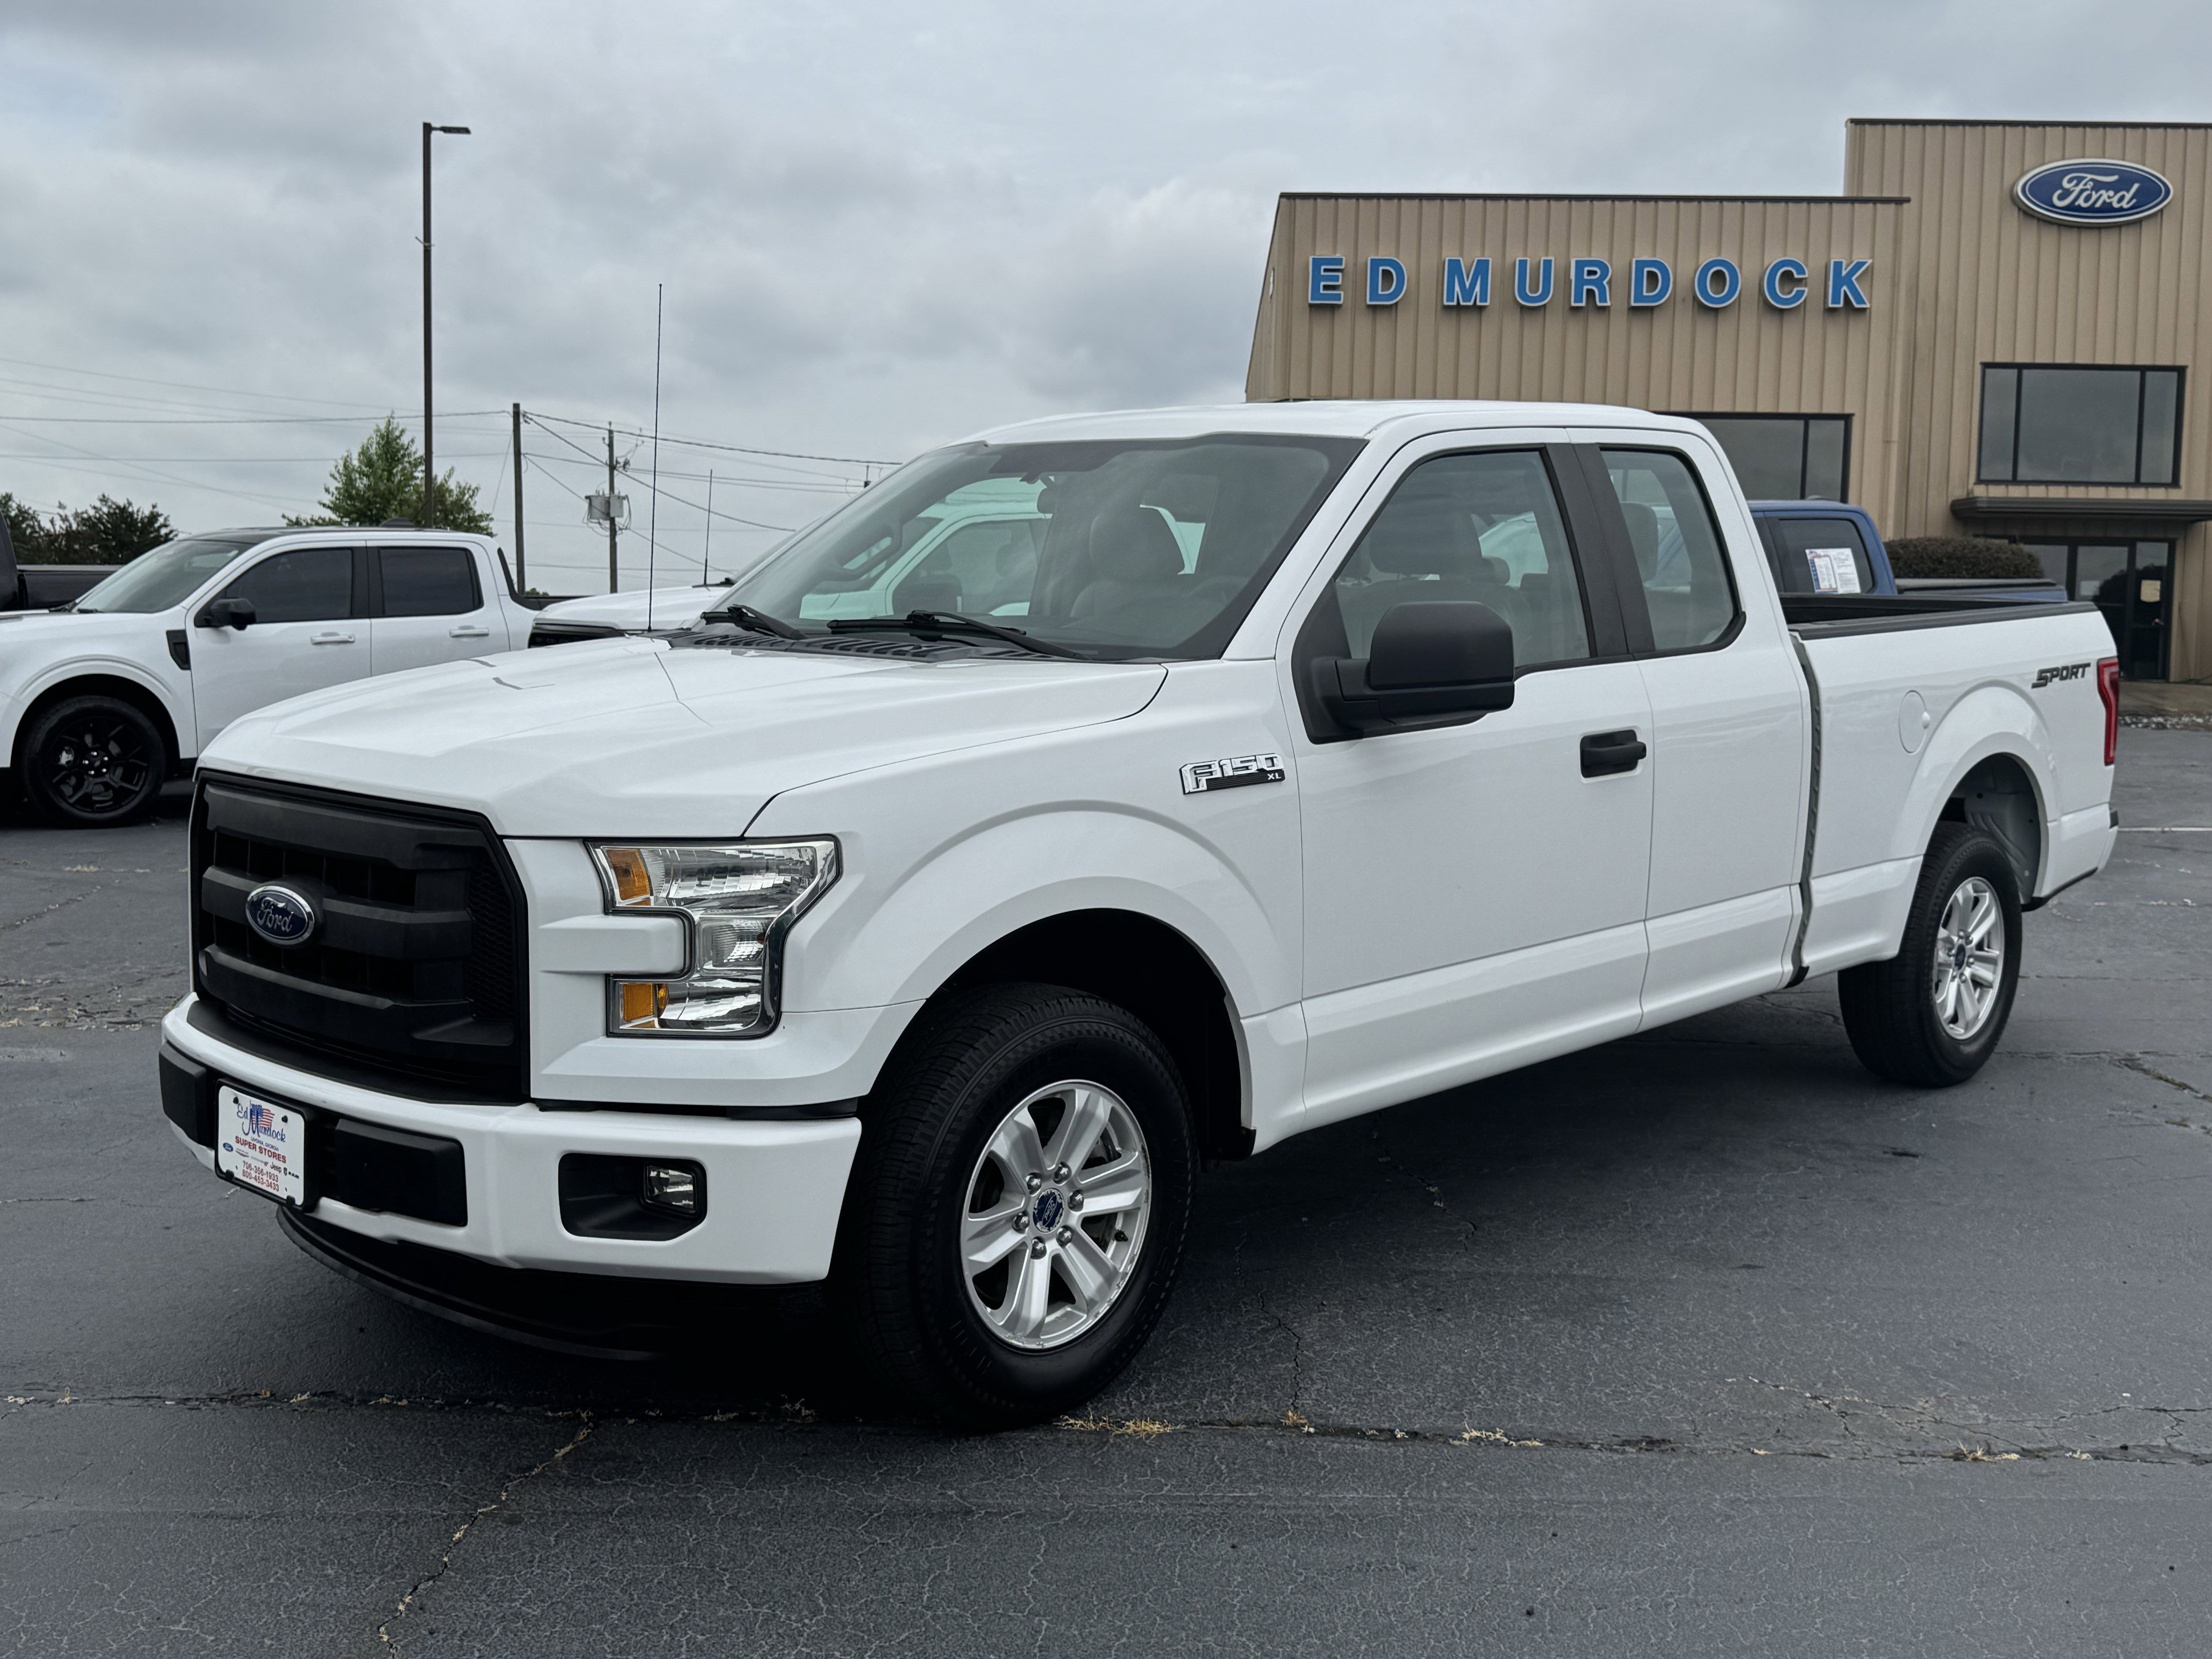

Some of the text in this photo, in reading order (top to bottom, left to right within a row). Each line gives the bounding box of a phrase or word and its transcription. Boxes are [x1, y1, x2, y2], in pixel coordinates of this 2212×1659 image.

[2052, 173, 2140, 208] Ford
[1309, 256, 1872, 309] ED MURDOCK
[2031, 662, 2091, 689] SPORT
[257, 897, 294, 932] Ford
[237, 1103, 248, 1120] Ed
[242, 1100, 285, 1142] Murdock
[235, 1135, 256, 1152] SUPER
[259, 1146, 286, 1163] STORES
[270, 1162, 282, 1173] Jeep
